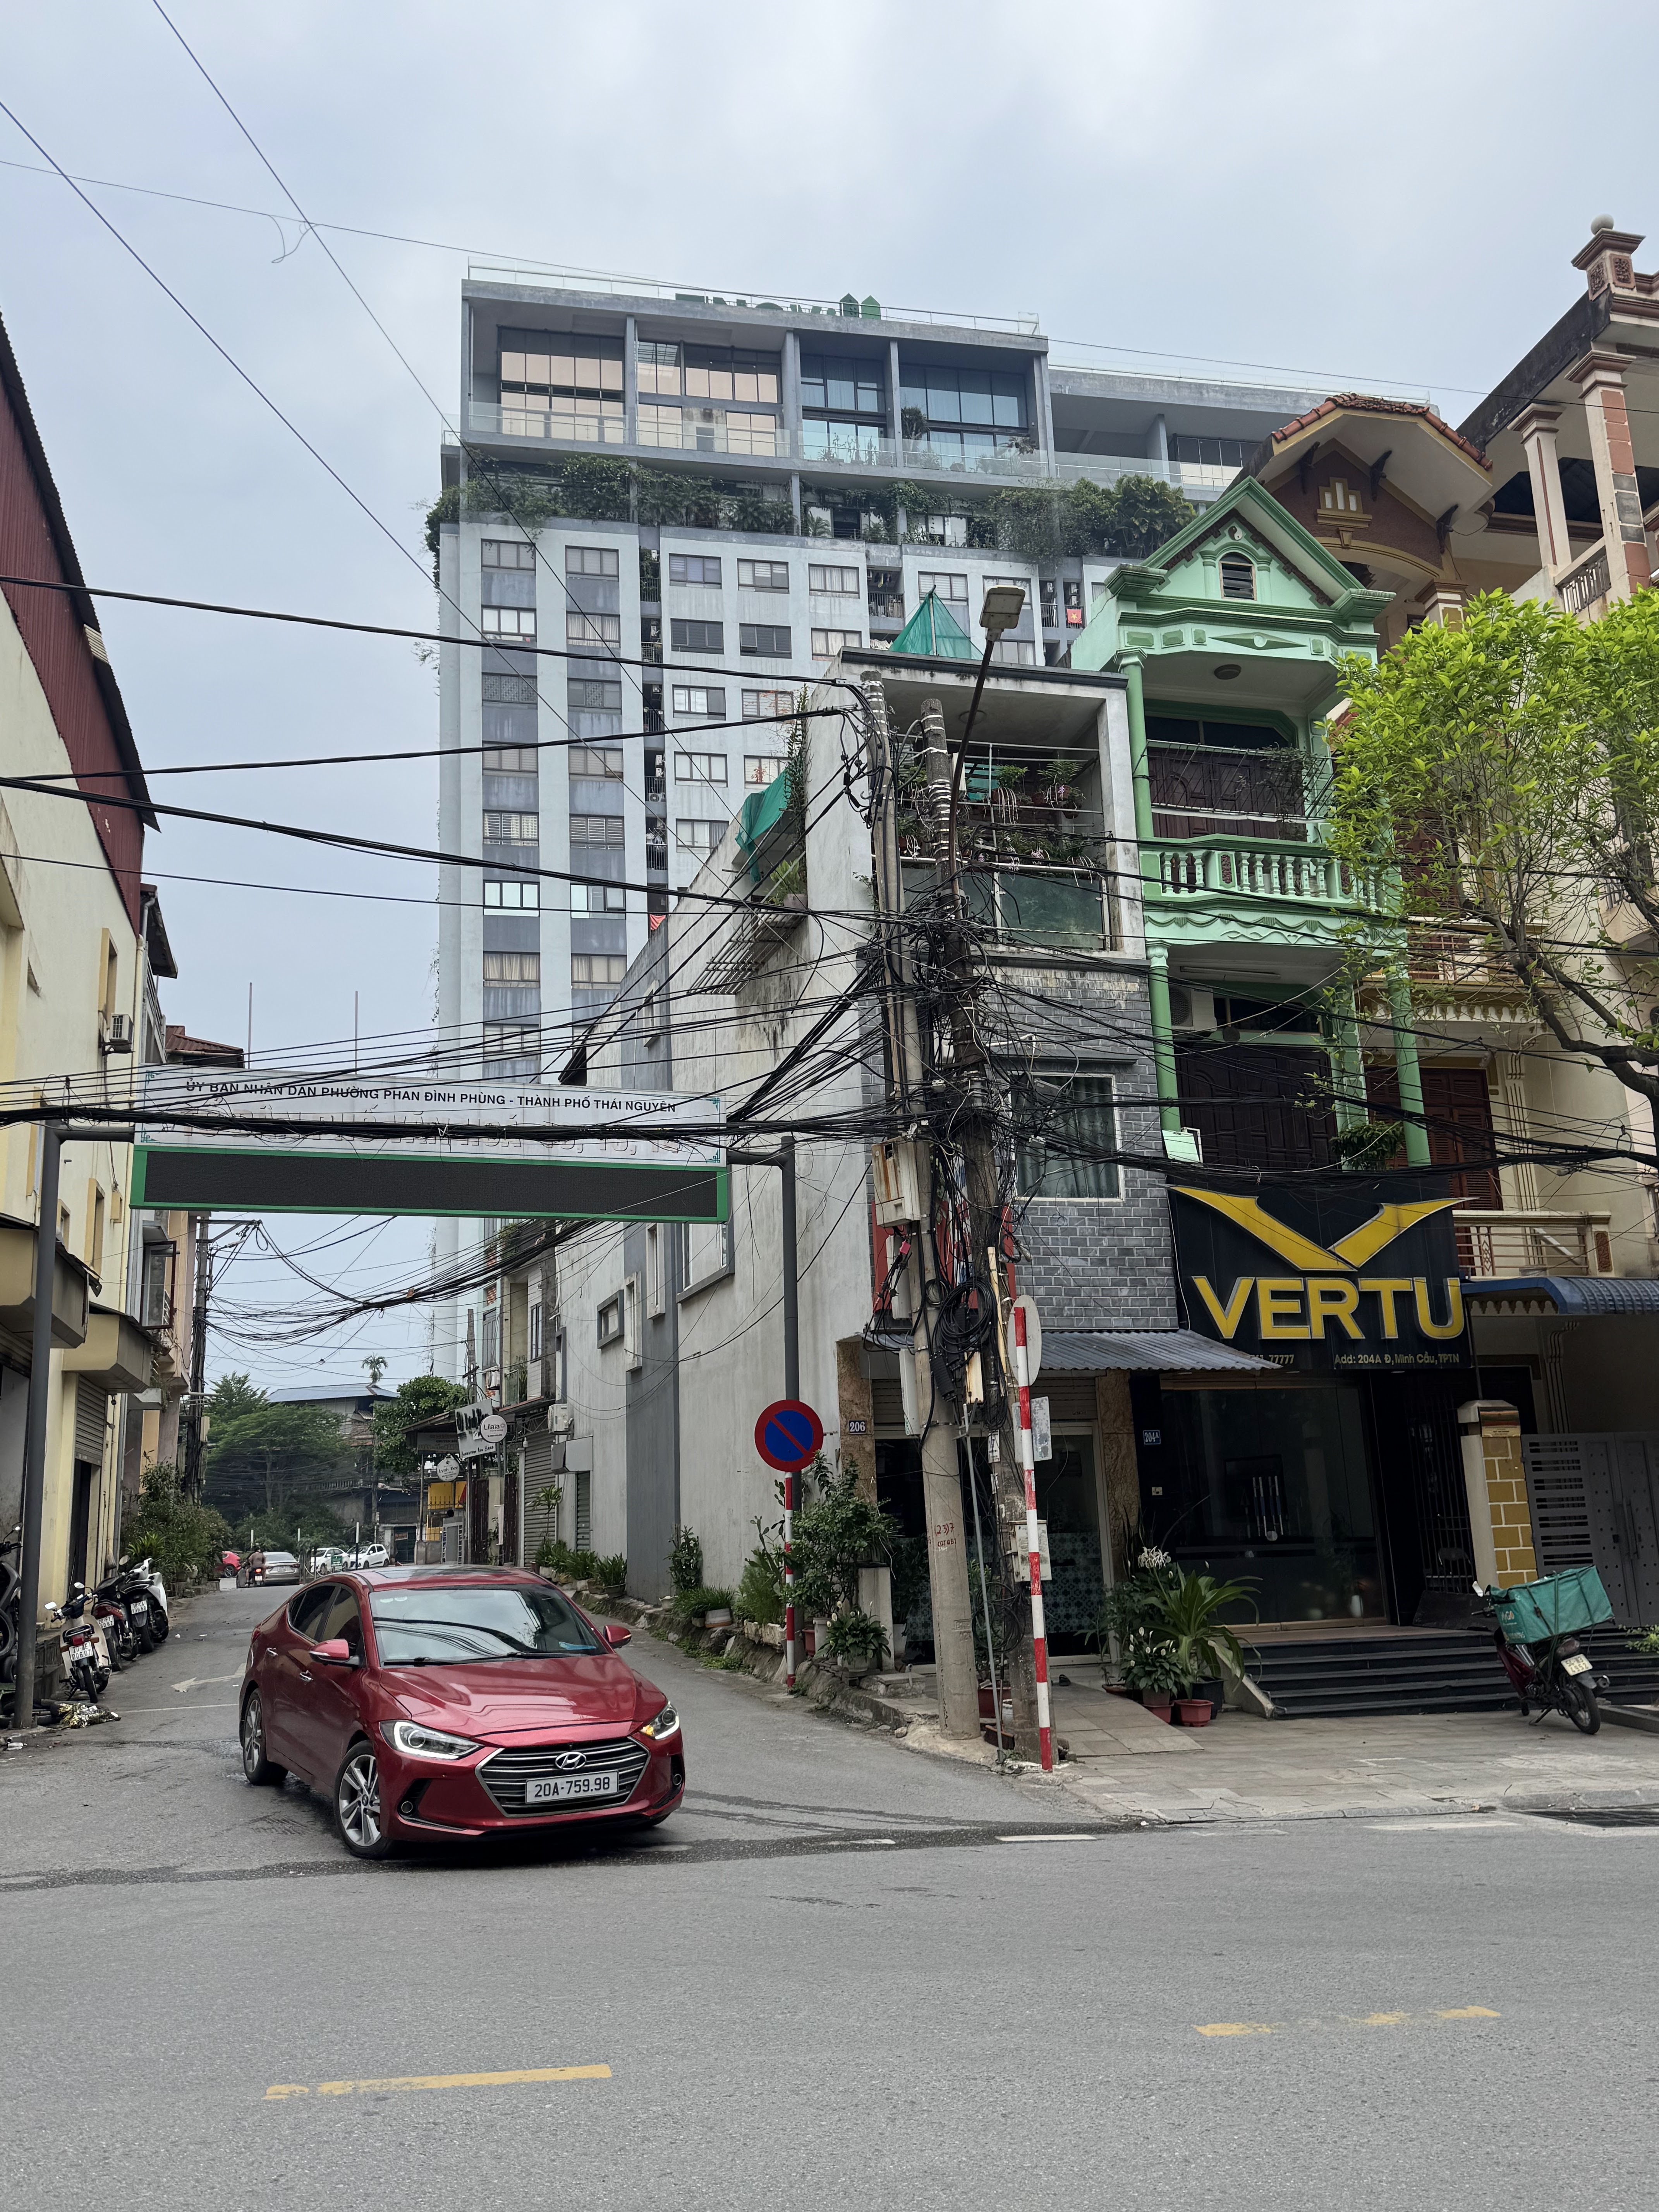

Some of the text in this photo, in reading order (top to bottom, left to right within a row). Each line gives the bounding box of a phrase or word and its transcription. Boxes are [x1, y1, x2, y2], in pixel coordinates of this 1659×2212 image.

[210, 1083, 238, 1092] BAN
[244, 1082, 282, 1095] NHÂN
[322, 1086, 378, 1099] PHƯỜNG
[384, 1090, 419, 1101] PHAN
[424, 1090, 455, 1103] ĐÌNH
[460, 1092, 505, 1104] PHÙNG
[517, 1094, 560, 1107] THÀNH
[565, 1096, 591, 1109] PHỐ
[594, 1098, 622, 1110] THÁI
[626, 1101, 675, 1112] NGUYÊN
[1191, 1276, 1465, 1339] VERTU
[1334, 1354, 1356, 1364] Add:
[1358, 1354, 1382, 1364] 204A
[850, 1421, 866, 1432] 206
[1144, 1432, 1159, 1442] 204A
[534, 1776, 610, 1798] 20A-759.98
